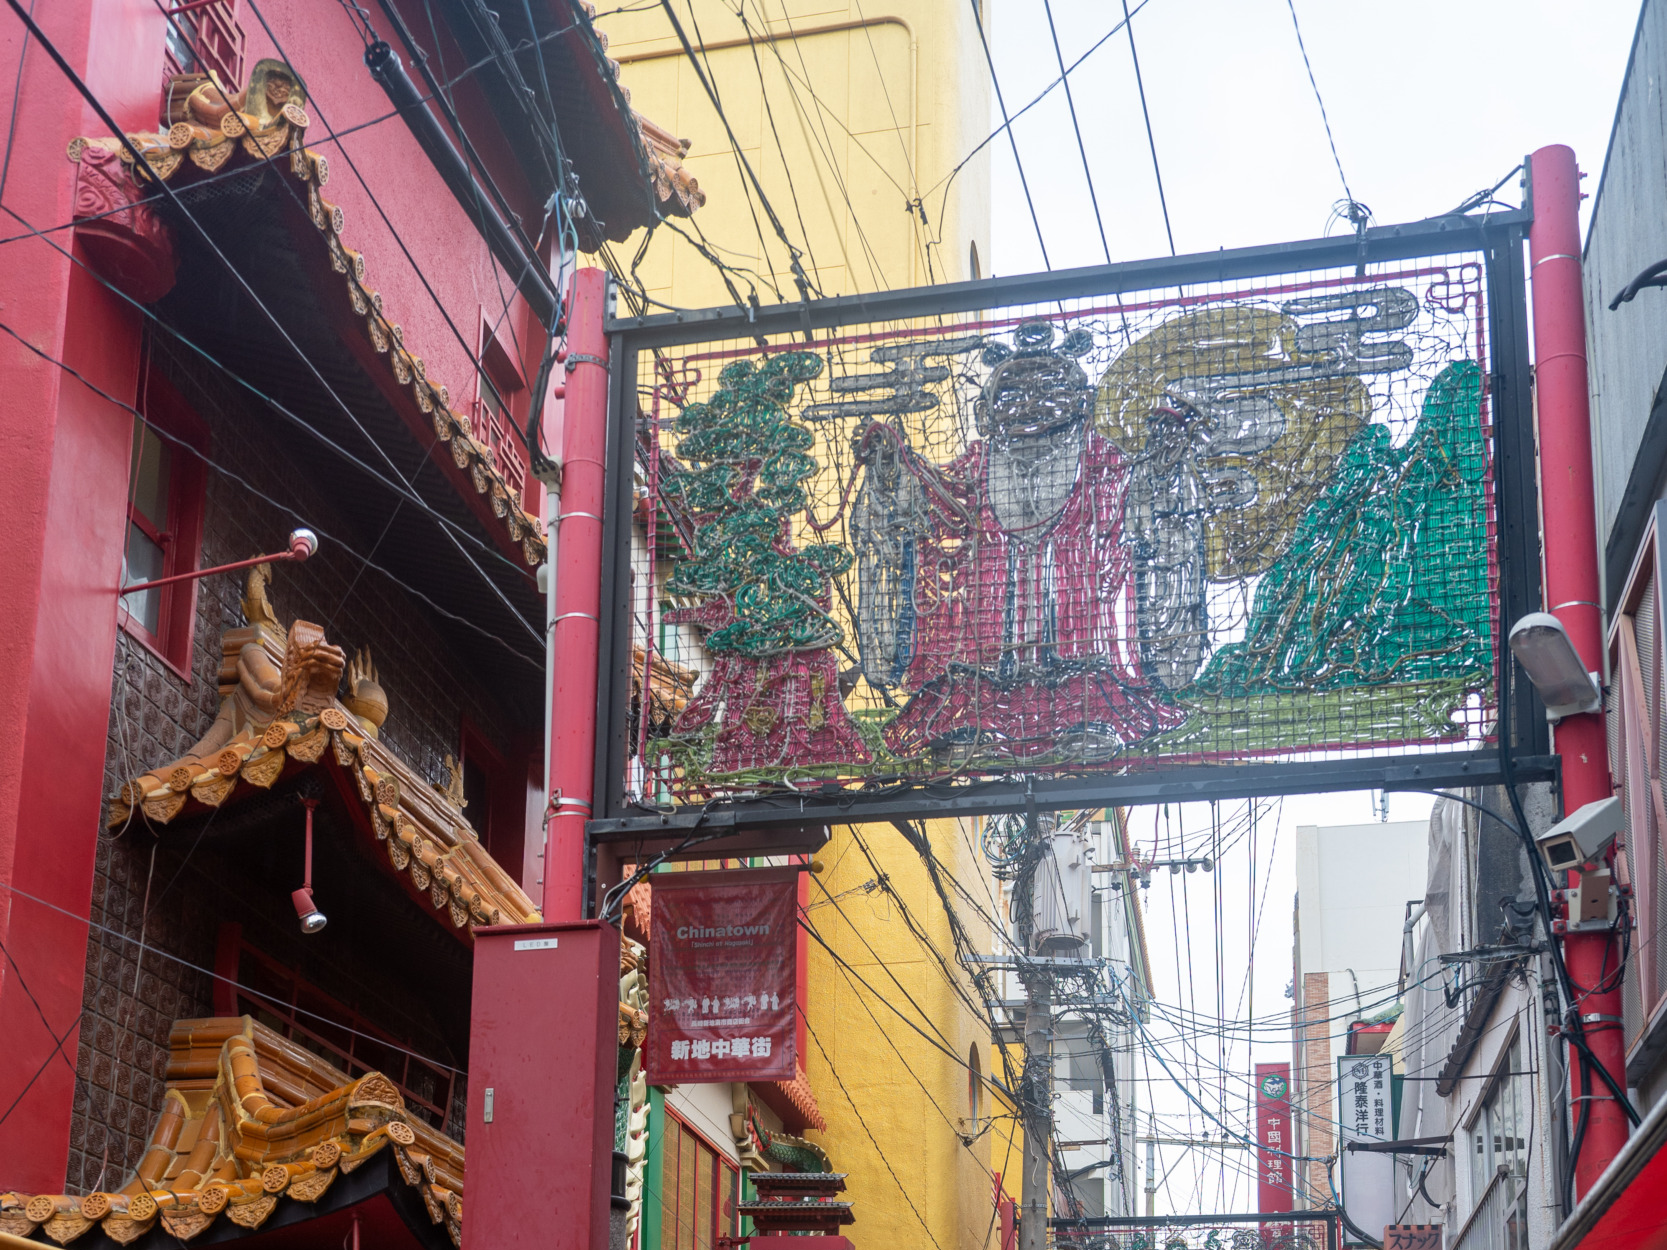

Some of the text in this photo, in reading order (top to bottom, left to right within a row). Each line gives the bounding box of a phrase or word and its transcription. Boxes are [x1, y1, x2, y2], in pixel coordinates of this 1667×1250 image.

[676, 924, 770, 940] Chinatown
[670, 1036, 772, 1060] 新地中華街
[1354, 1081, 1369, 1137] 隆泰洋行
[1373, 1060, 1385, 1136] 中華酒・料理材料
[1388, 1232, 1440, 1250] スナック
